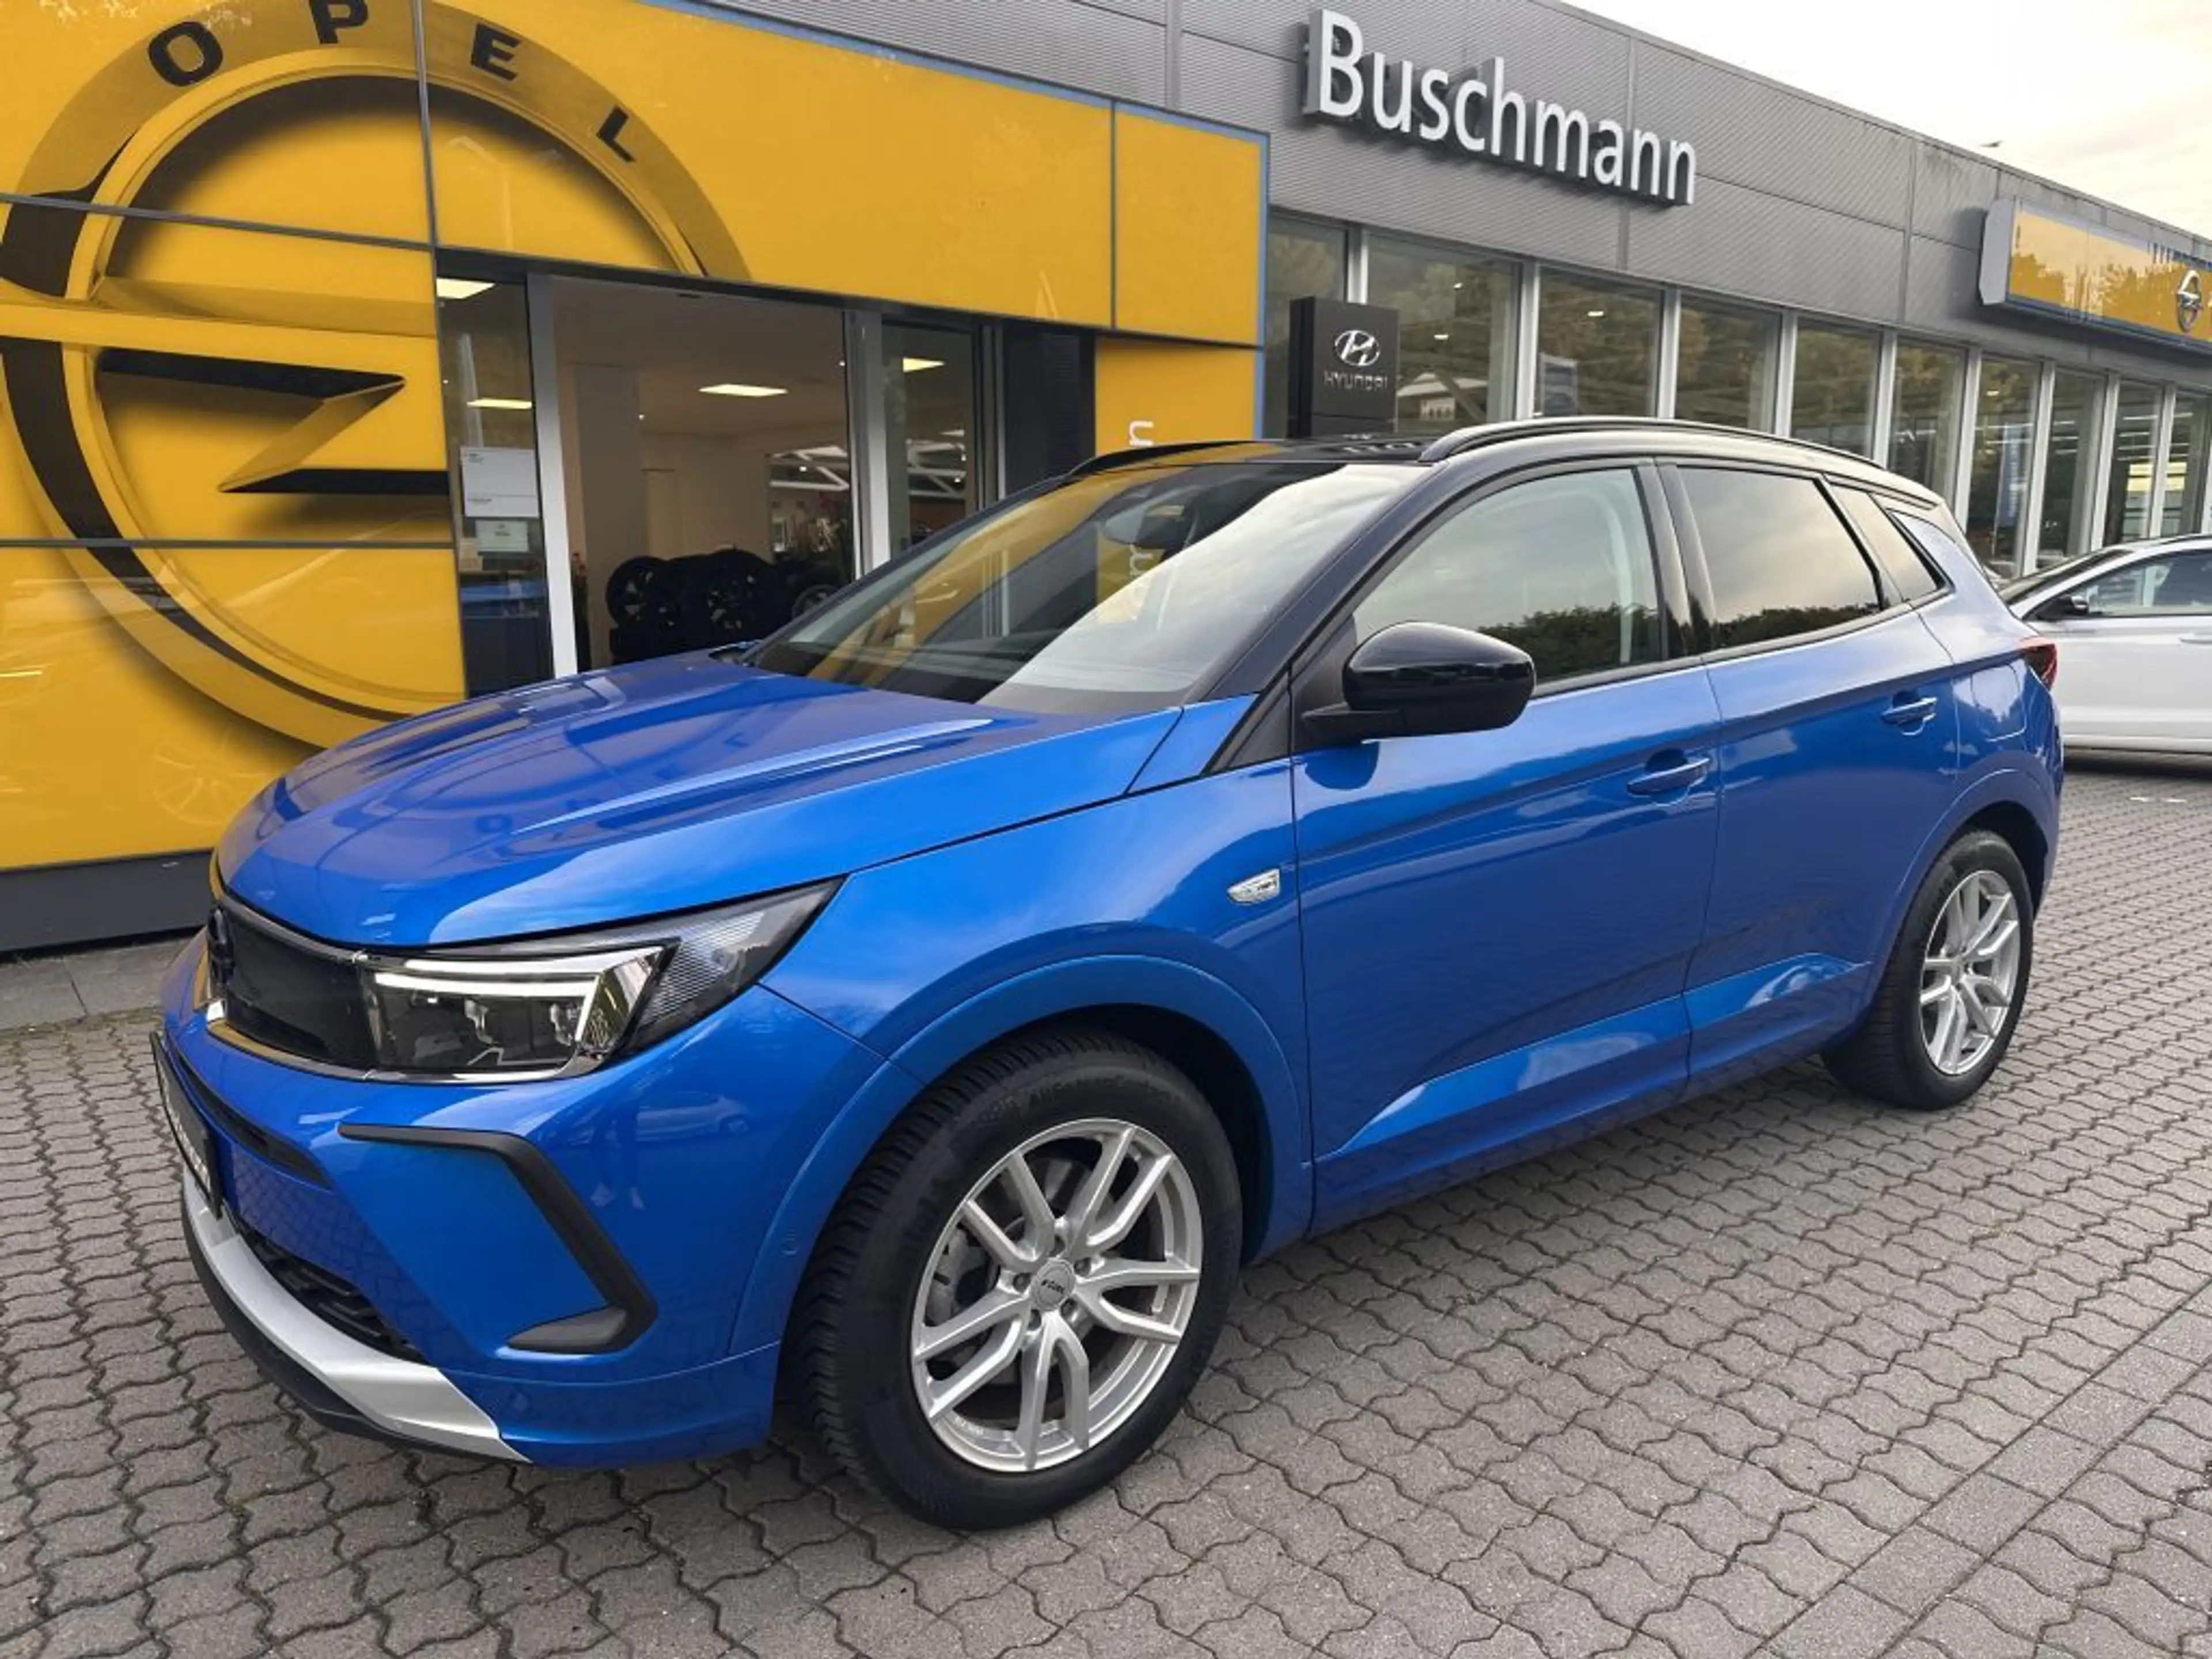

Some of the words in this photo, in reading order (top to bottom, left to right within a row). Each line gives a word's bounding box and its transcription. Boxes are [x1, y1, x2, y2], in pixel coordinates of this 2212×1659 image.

[147, 0, 637, 163] OPEL
[1306, 8, 1696, 204] Buschmann
[1323, 370, 1388, 392] HYUNDAI
